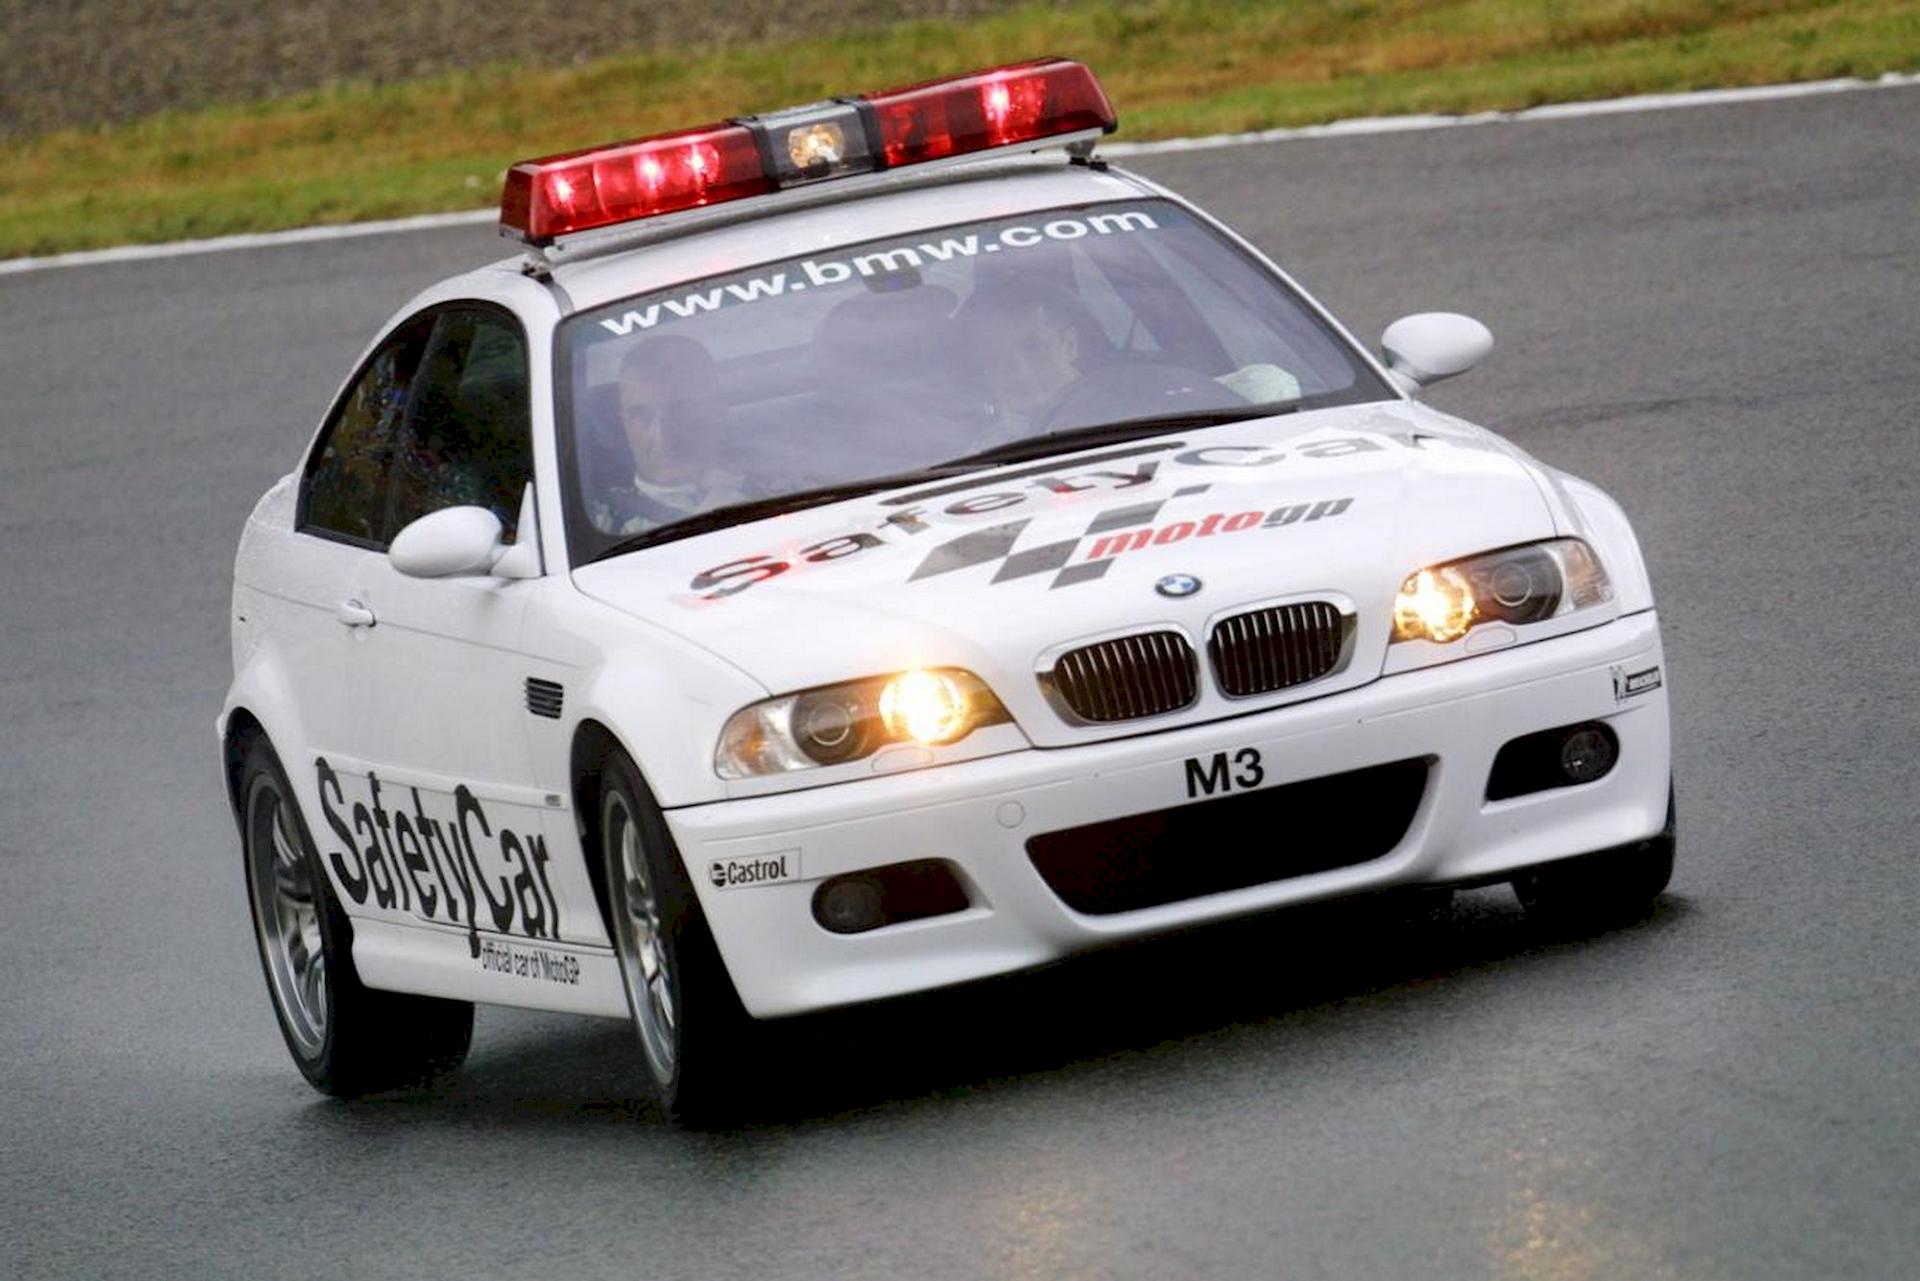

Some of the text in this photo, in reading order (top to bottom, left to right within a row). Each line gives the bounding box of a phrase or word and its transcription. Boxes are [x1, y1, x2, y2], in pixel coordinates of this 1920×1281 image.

[600, 209, 1158, 336] www.bmw.com
[1087, 498, 1354, 560] motogp
[1184, 747, 1264, 798] M3
[315, 757, 559, 959] SafetyCar
[727, 856, 788, 885] Castrol
[514, 953, 529, 977] car
